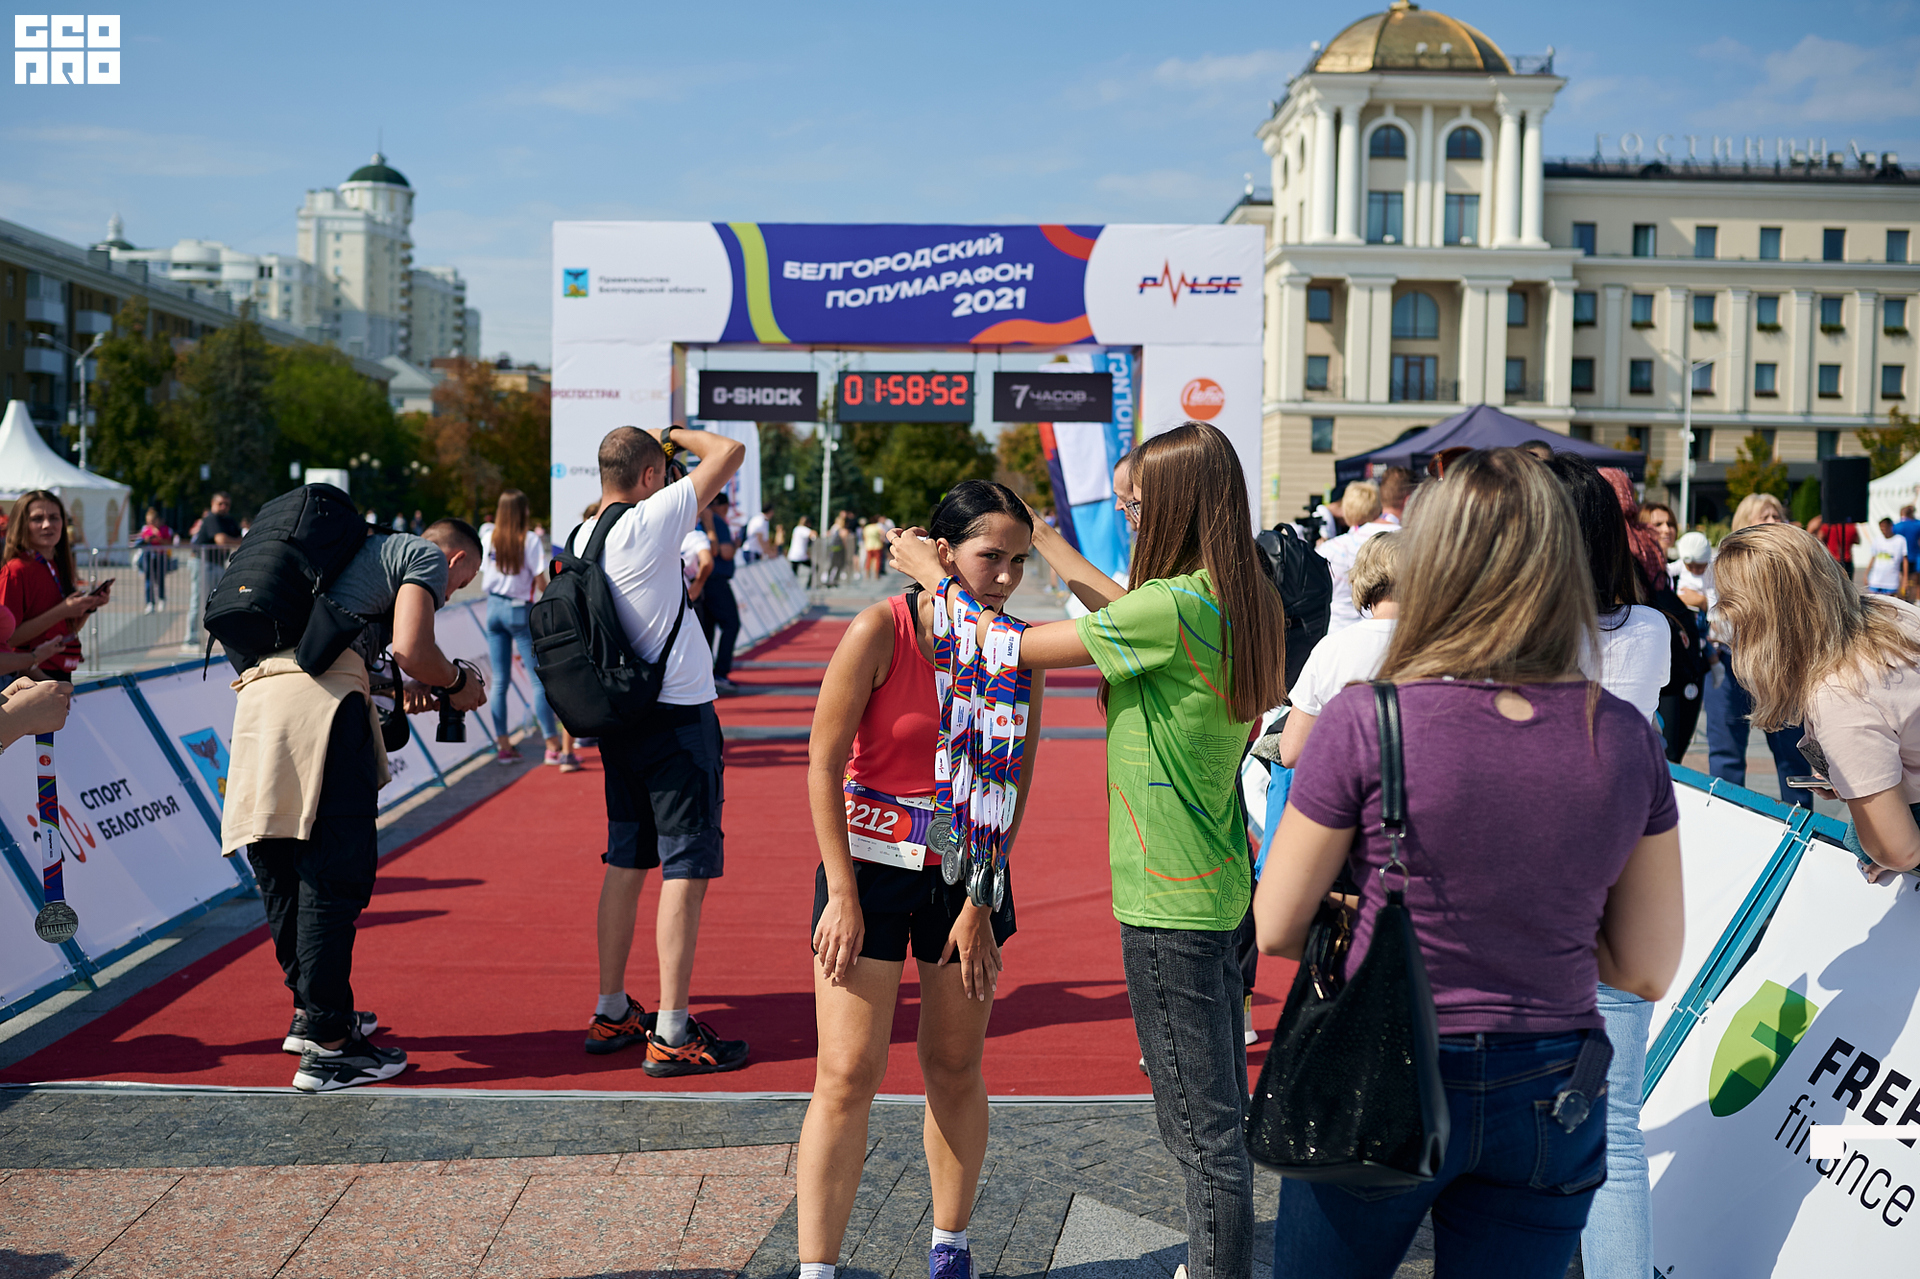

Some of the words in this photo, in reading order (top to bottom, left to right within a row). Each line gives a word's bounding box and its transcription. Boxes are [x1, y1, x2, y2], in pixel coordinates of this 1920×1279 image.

[1596, 132, 1863, 164] ГОСТИНИЦА
[783, 232, 1004, 281] БЕЛГОРОДСКИЙ
[825, 263, 1034, 309] ПОЛУМАРАФОН
[951, 286, 1027, 318] 2021
[713, 387, 803, 406] G-SHOCK
[844, 374, 969, 406] 01:58:52
[1009, 384, 1031, 410] 7
[80, 778, 132, 810] СПОРТ
[96, 795, 181, 840] БЕЛОГОРЬЯ
[845, 800, 899, 836] 2212
